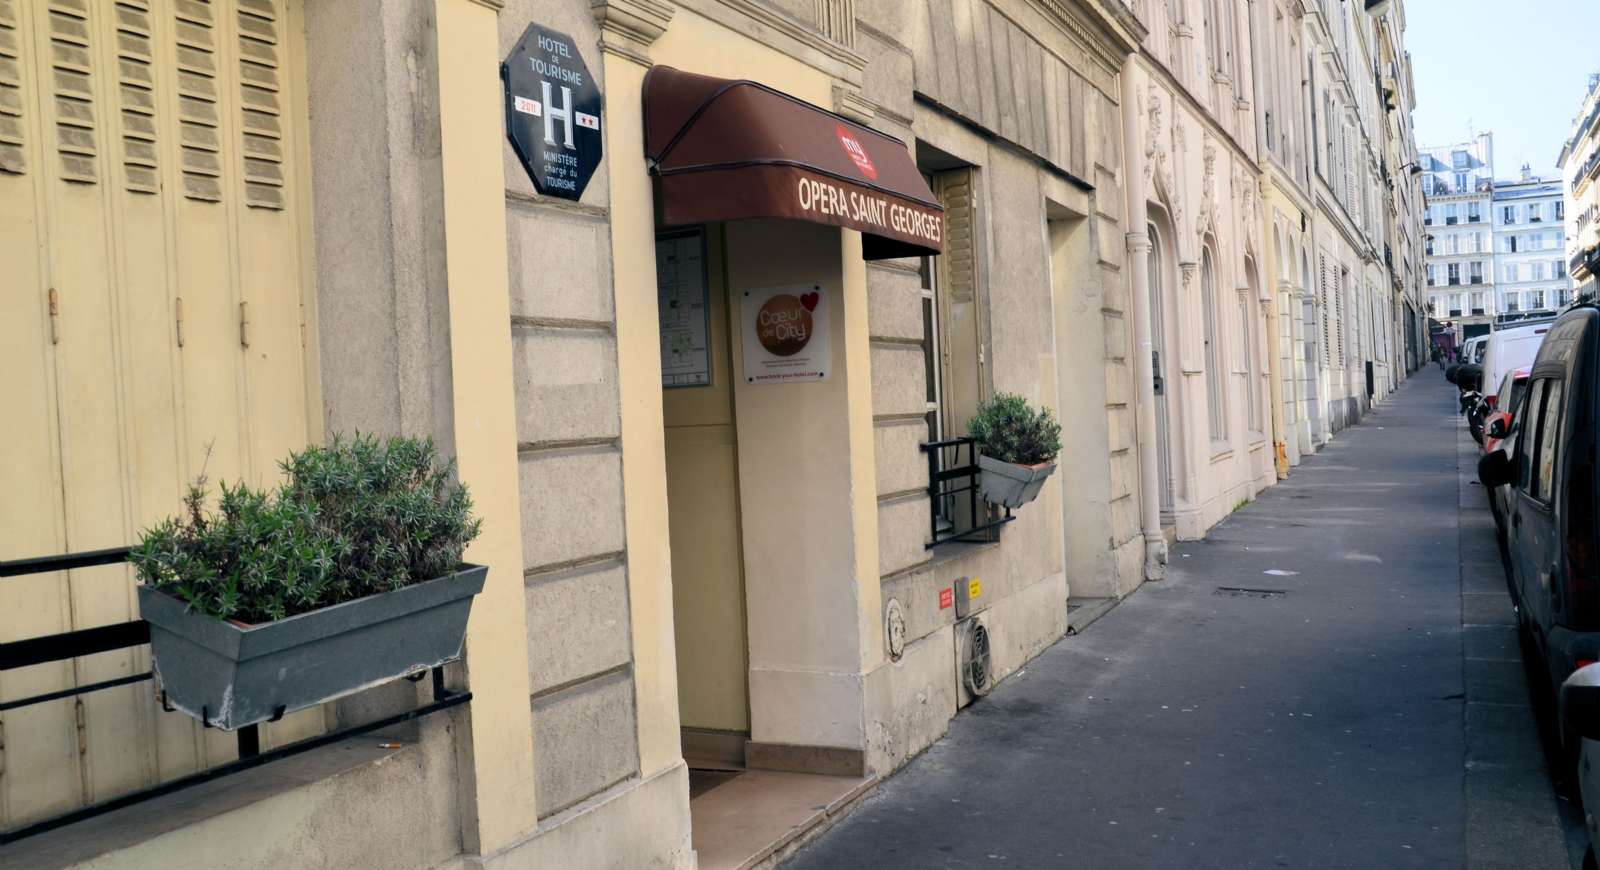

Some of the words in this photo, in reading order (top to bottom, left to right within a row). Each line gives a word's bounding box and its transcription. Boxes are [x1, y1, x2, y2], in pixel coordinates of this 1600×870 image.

[538, 35, 571, 58] HOTEL
[551, 56, 559, 64] DE
[529, 58, 582, 86] TOURISME
[521, 101, 536, 113] 2011
[540, 80, 576, 150] H
[543, 151, 578, 167] MINISTÈRE
[569, 169, 578, 177] du
[546, 176, 576, 191] TOURISME
[798, 177, 850, 218] OPERA
[851, 191, 887, 228] SAINT
[890, 203, 941, 242] GEORGES
[775, 321, 806, 341] City
